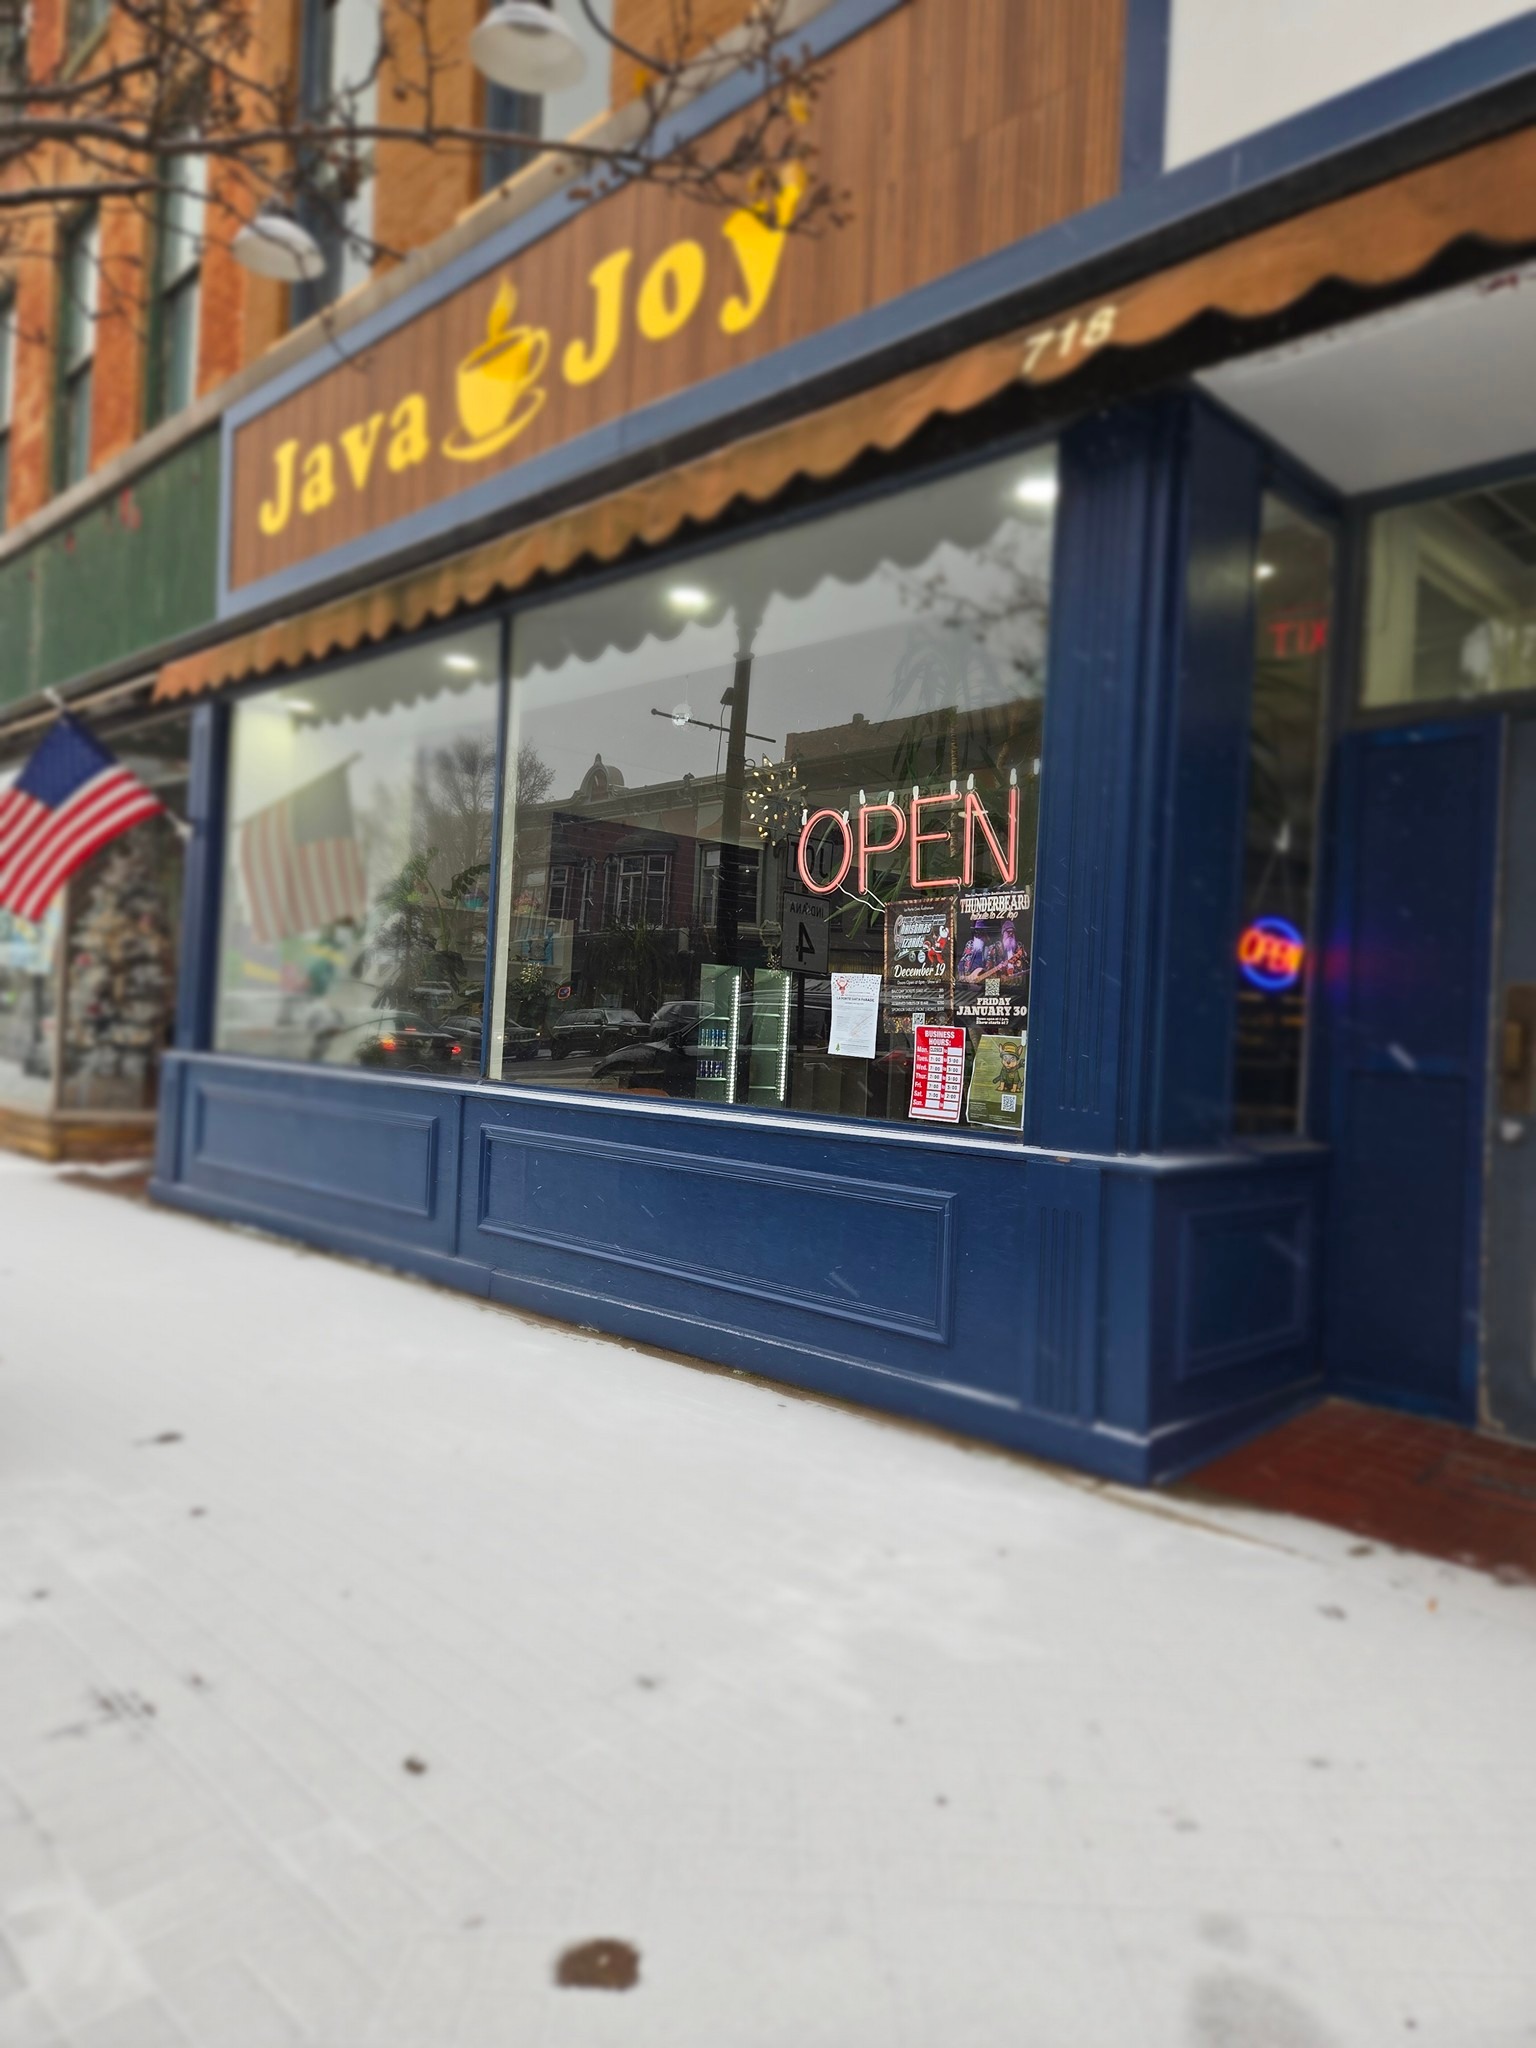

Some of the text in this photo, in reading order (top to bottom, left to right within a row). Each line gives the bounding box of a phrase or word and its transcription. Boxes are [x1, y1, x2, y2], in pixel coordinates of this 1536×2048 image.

[1022, 306, 1116, 373] 718
[259, 161, 808, 536] Java Joy
[797, 785, 1020, 895] OPEN
[960, 895, 1030, 913] THUNDERBEARD
[1007, 910, 1018, 921] Top
[1238, 929, 1304, 973] OPEN
[894, 962, 945, 977] December 19
[957, 1006, 1027, 1016] JANUARY 30
[925, 1030, 955, 1039] BUSINESS
[929, 1038, 951, 1046] HOURS:
